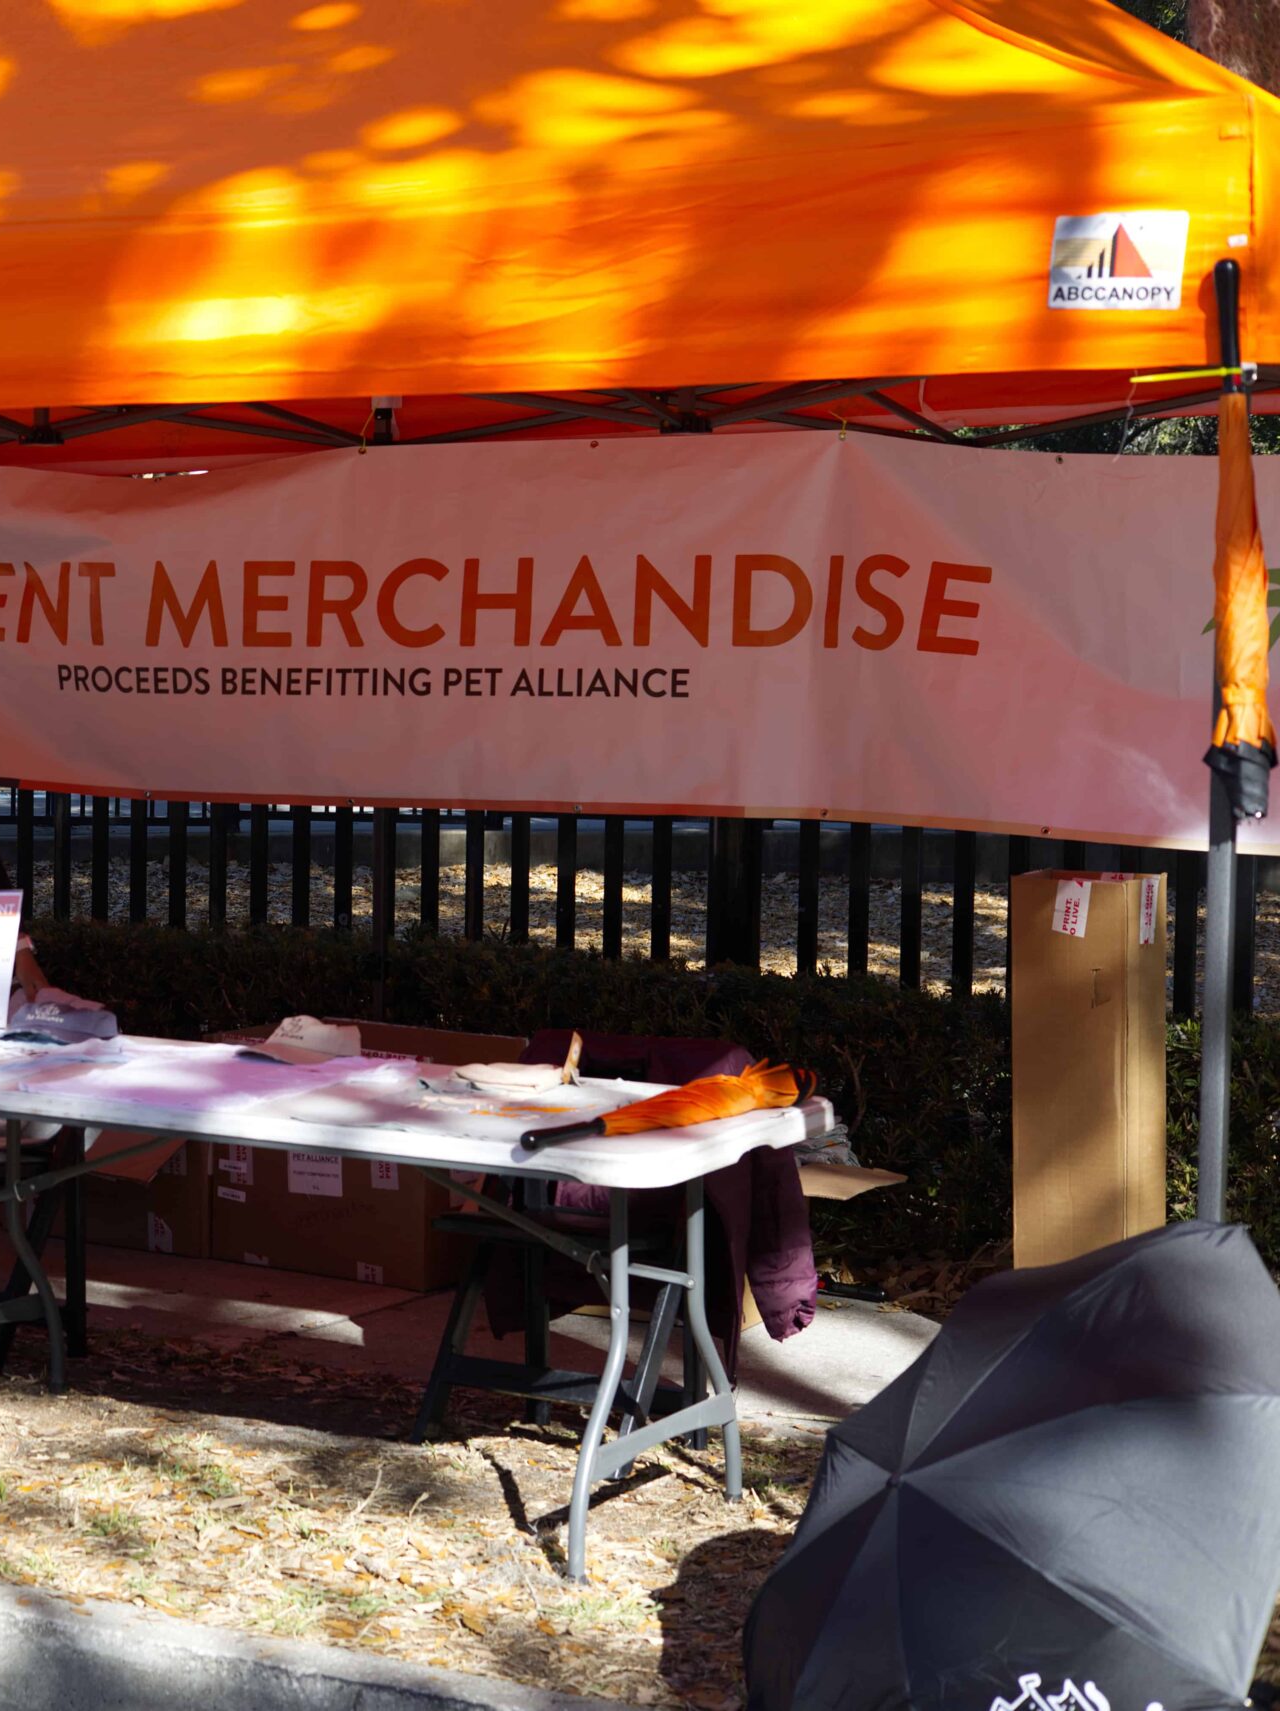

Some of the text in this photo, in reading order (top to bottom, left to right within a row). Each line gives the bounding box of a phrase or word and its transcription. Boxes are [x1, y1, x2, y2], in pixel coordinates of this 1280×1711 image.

[1053, 286, 1175, 302] ABCCANOPY
[145, 553, 992, 656] MERCHANDISE
[57, 664, 690, 699] PROCEEDS BENEFITTING PET ALLIANCE
[1062, 898, 1073, 931] PRINT.
[1072, 898, 1081, 924] LIVE.
[292, 1152, 339, 1165] PET ALLIANCE
